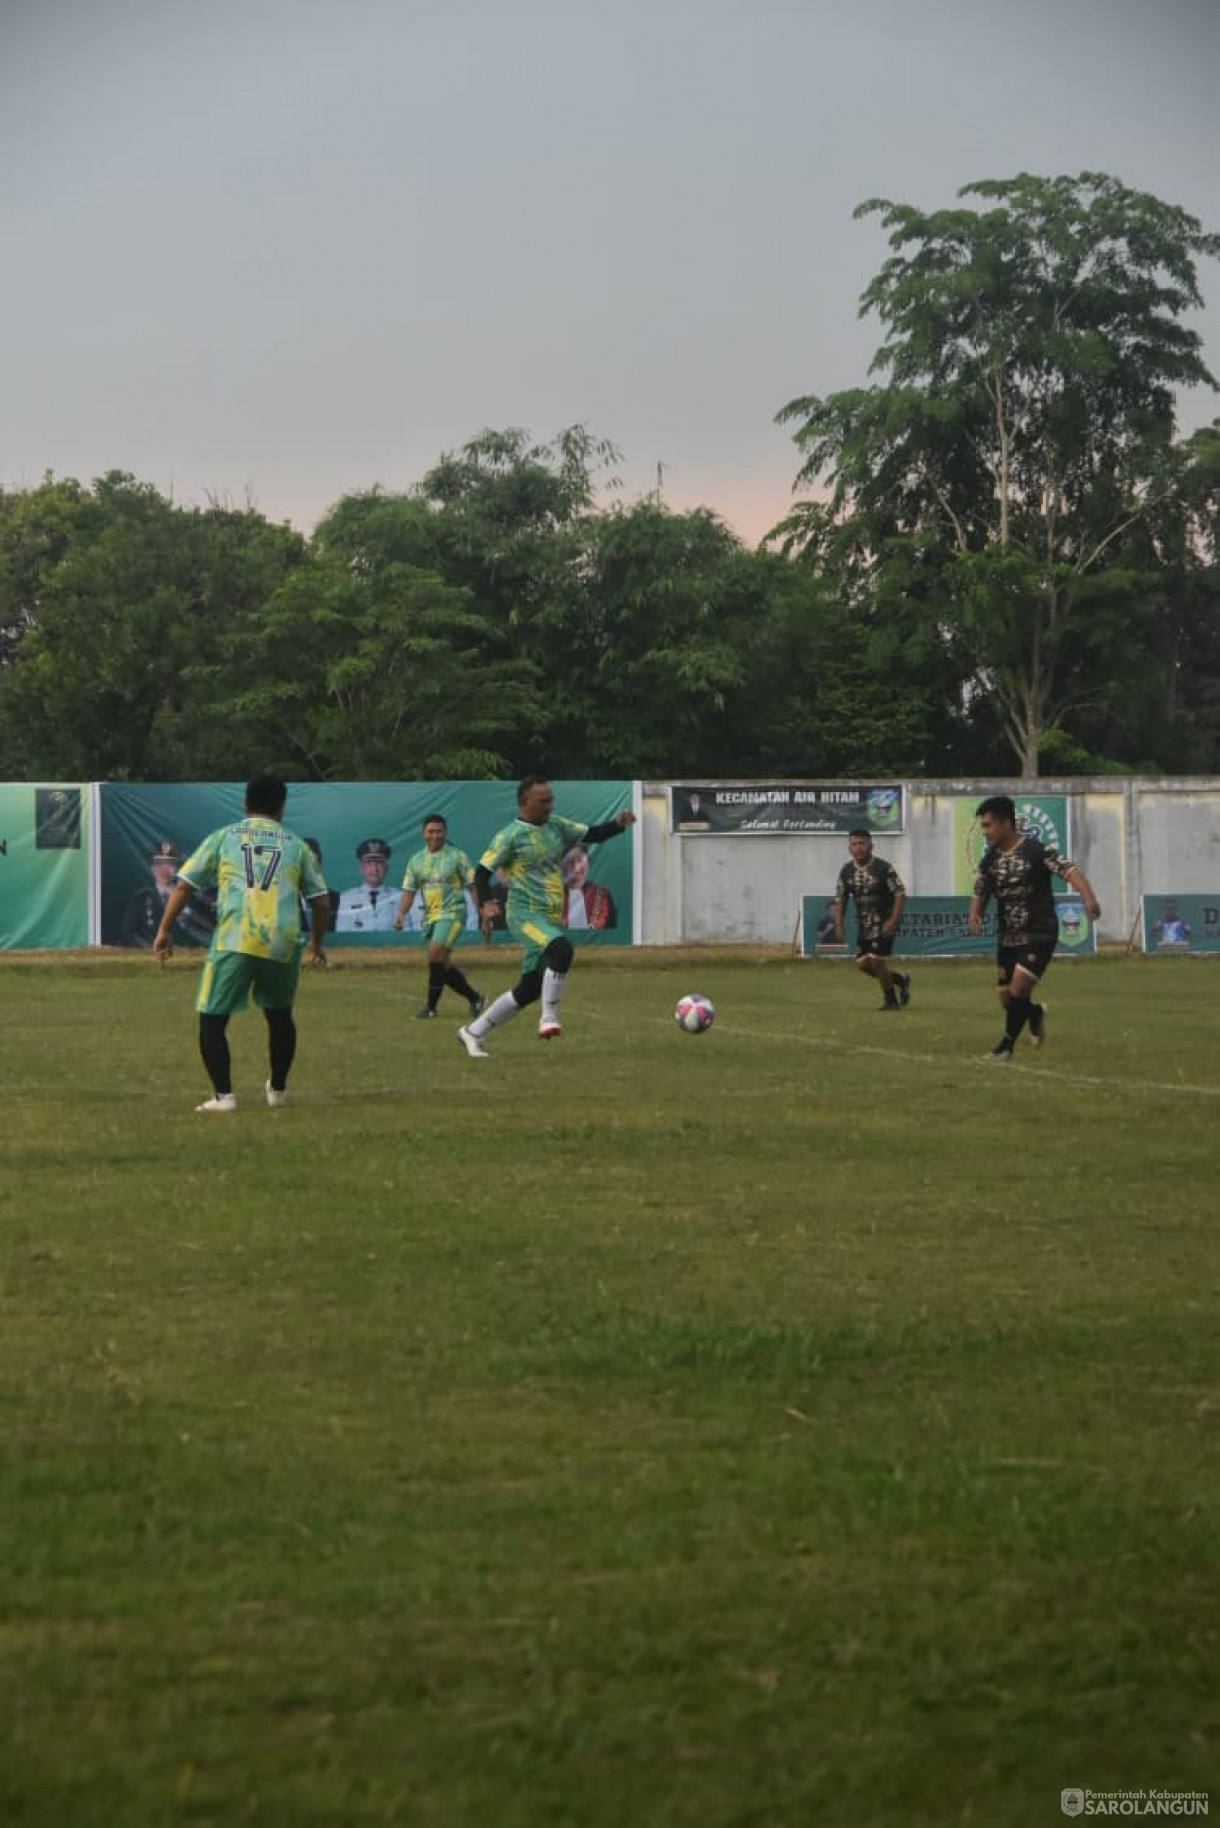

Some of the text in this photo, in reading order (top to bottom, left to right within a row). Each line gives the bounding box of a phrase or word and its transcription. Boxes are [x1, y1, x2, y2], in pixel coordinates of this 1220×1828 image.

[716, 791, 860, 804] KECAMATAN AIR HITAM
[241, 843, 282, 892] 17
